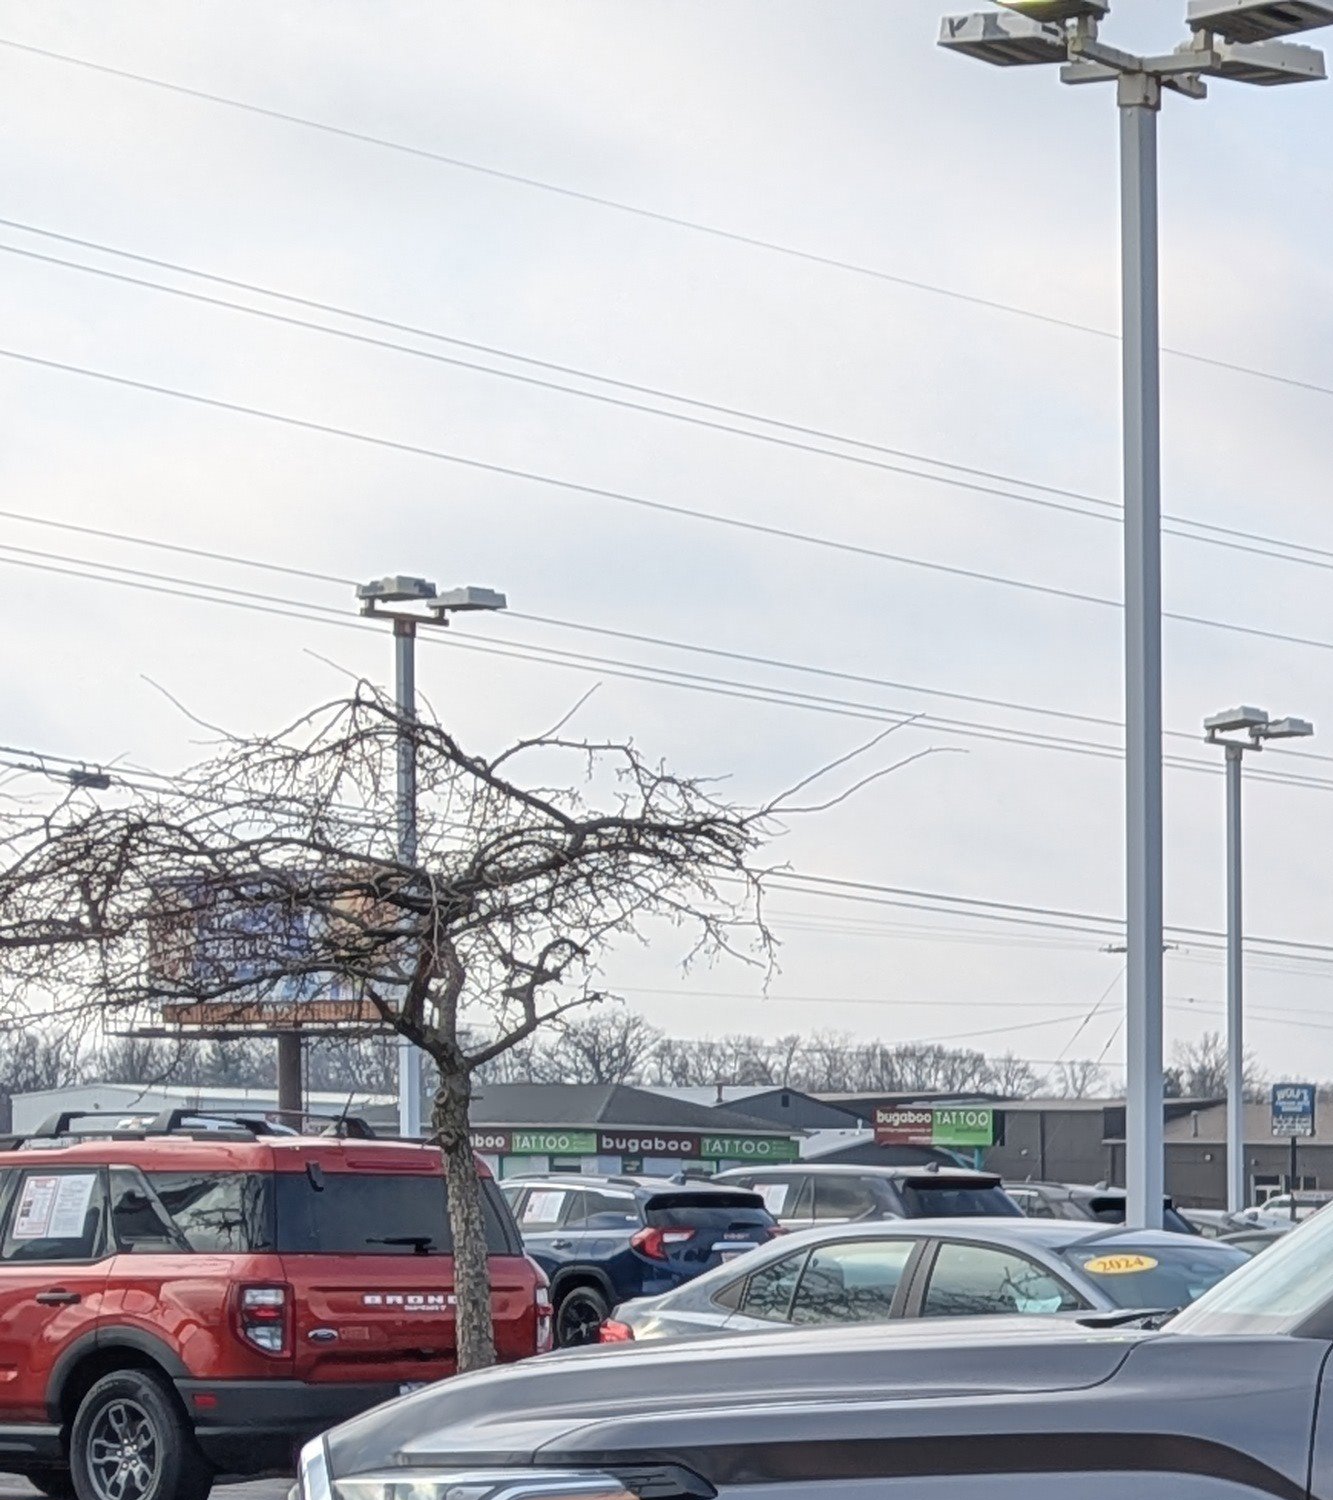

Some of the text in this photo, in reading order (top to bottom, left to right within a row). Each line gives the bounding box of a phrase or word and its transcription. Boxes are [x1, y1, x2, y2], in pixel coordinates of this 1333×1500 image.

[876, 1109, 932, 1126] bugaboo
[935, 1111, 988, 1126] TATTOO
[515, 1135, 570, 1150] TATTOO
[601, 1135, 693, 1153] bugaboo
[703, 1137, 770, 1155] TATTOO
